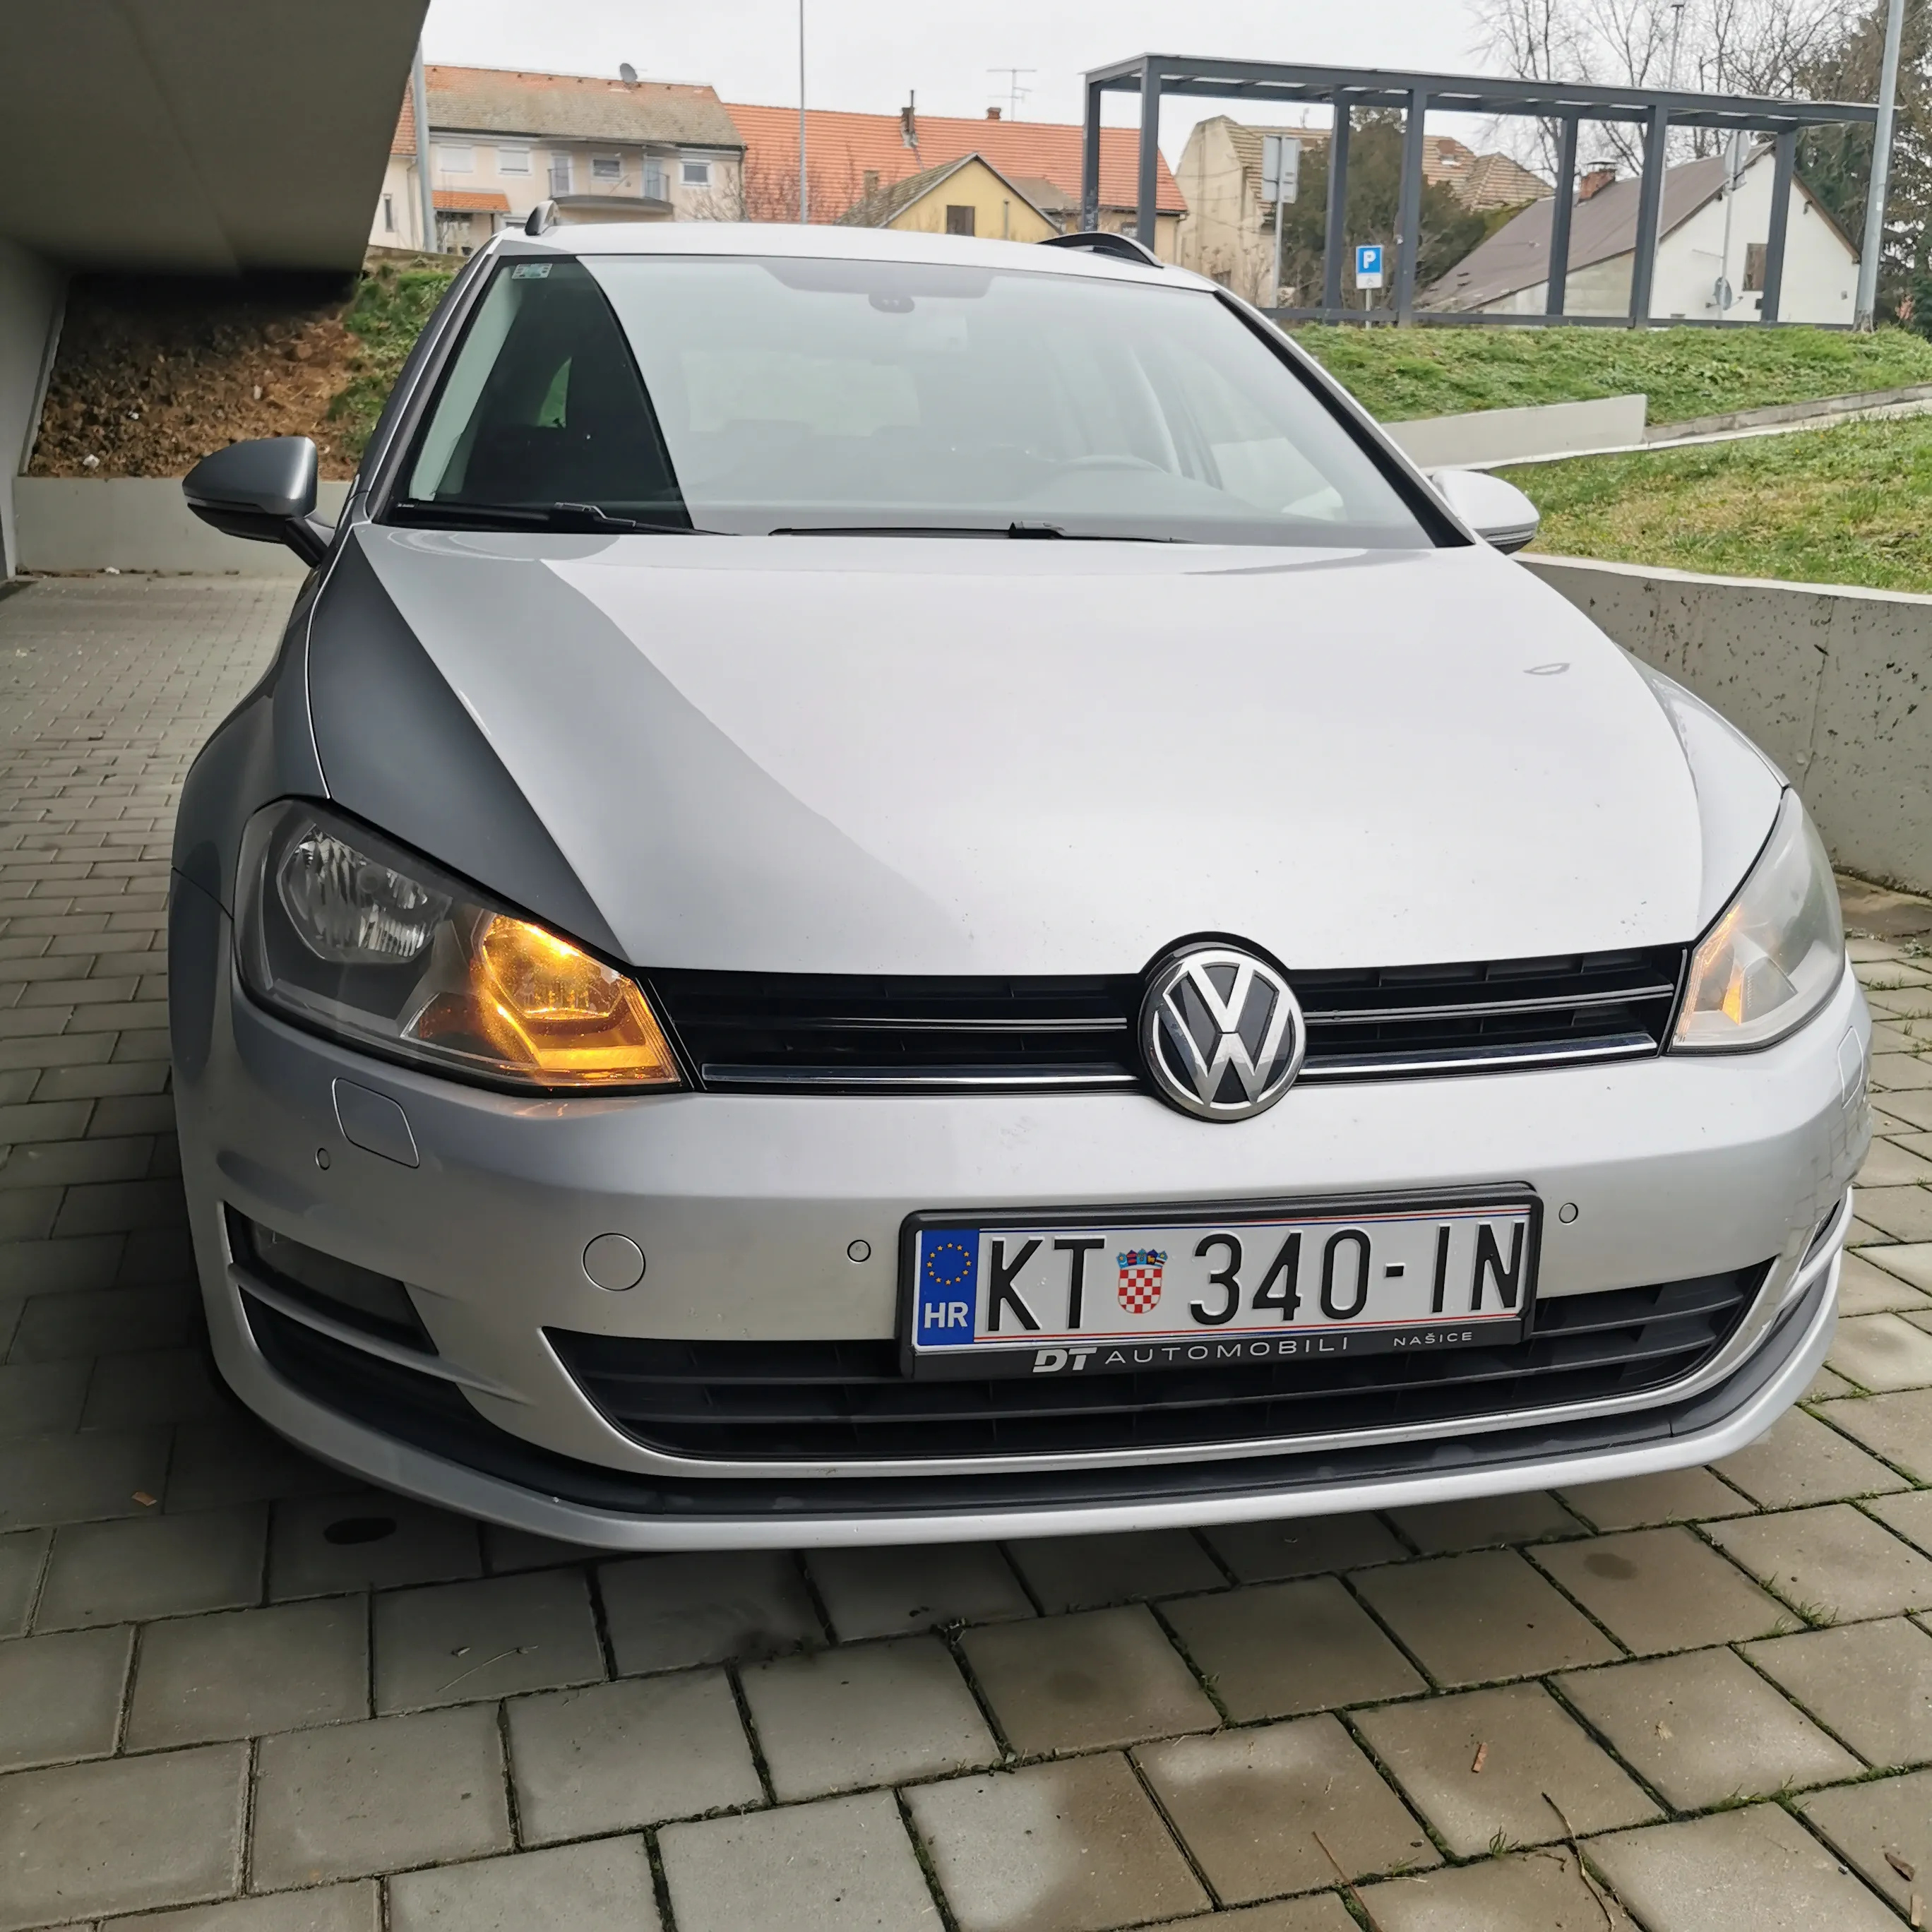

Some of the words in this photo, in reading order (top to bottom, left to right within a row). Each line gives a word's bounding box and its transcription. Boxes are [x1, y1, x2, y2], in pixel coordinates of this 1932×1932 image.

[1363, 249, 1376, 269] P
[1155, 956, 1294, 1107] VW
[987, 1236, 1107, 1332] KT
[923, 1301, 969, 1329] HR
[1032, 1346, 1098, 1373] DT
[1104, 1336, 1348, 1365] AUTOMOBILI
[1393, 1331, 1474, 1347] NAŠICE
